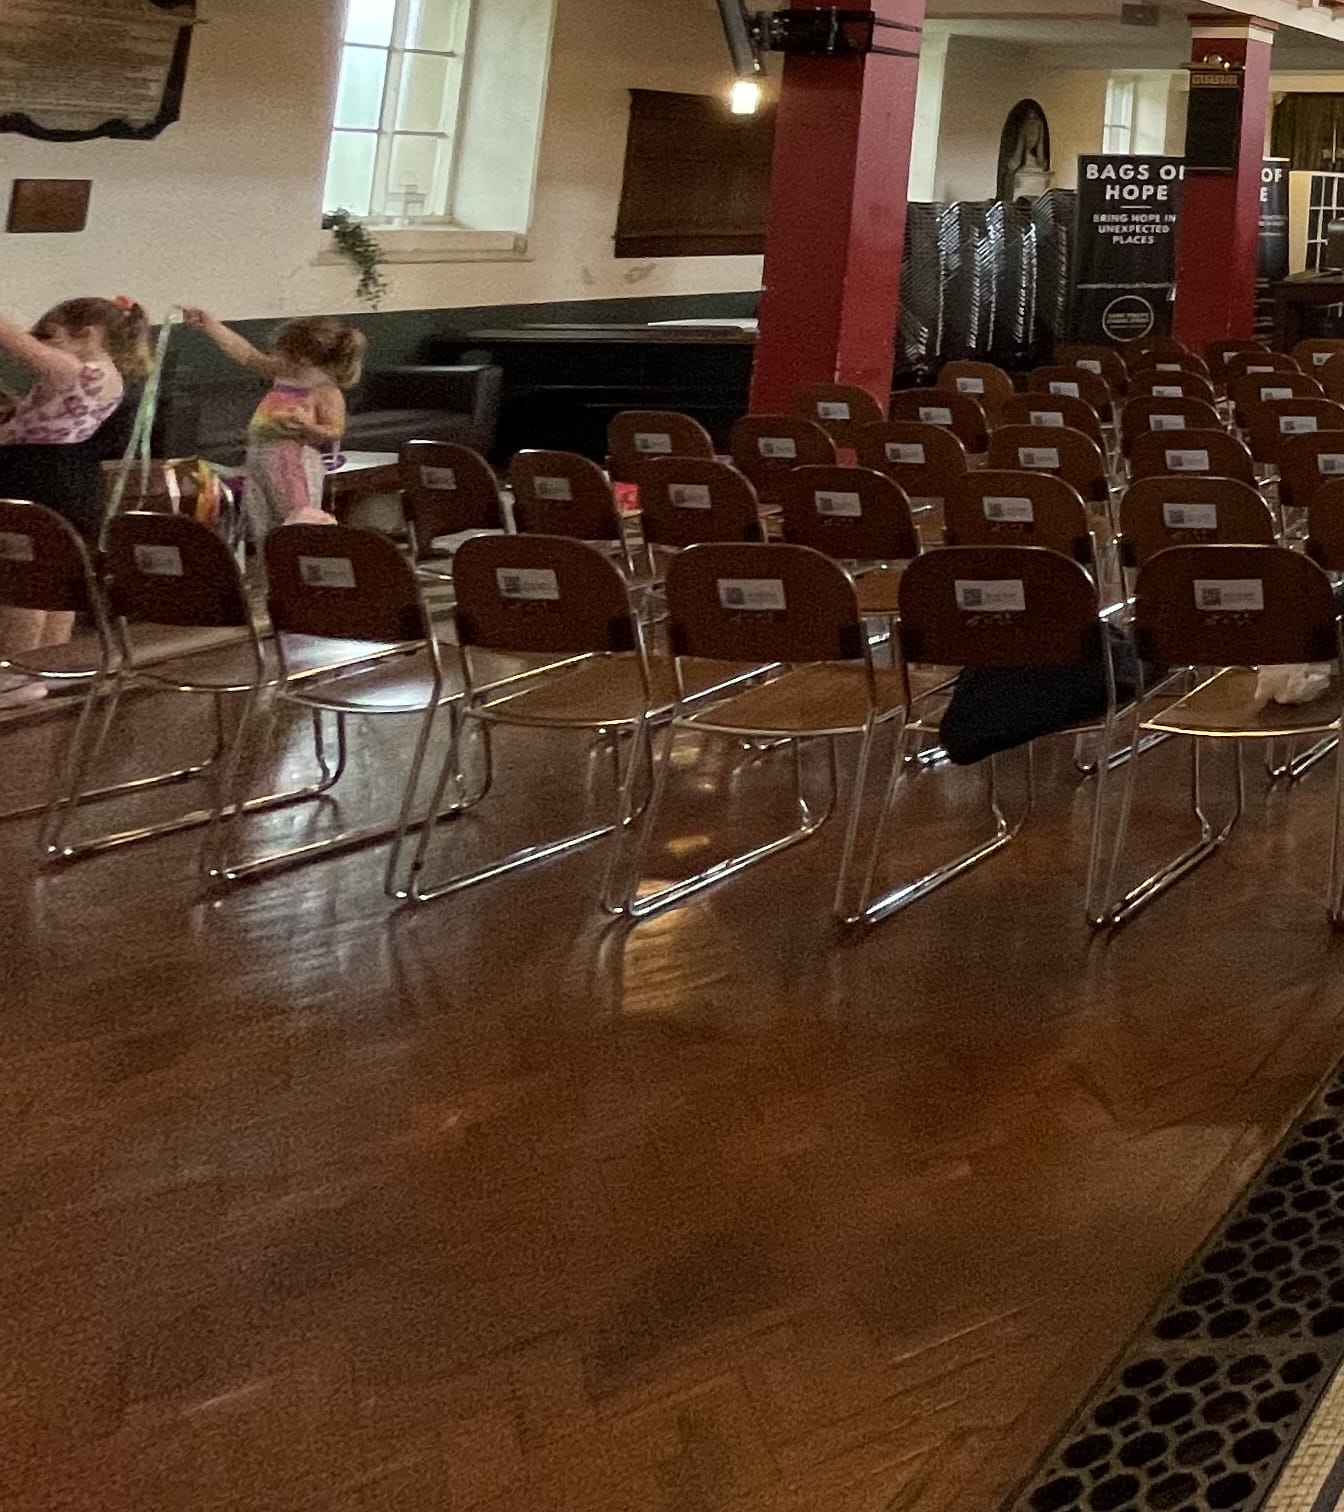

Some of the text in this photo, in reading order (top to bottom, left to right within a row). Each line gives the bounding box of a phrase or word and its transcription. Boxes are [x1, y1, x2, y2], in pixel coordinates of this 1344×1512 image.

[1086, 163, 1150, 180] BAGS
[1261, 167, 1283, 183] OF
[1105, 184, 1168, 200] HOPE
[1093, 214, 1177, 223] BRING HOPE IN
[1098, 224, 1170, 234] UNEXPECTED
[1112, 235, 1154, 245] PLACES
